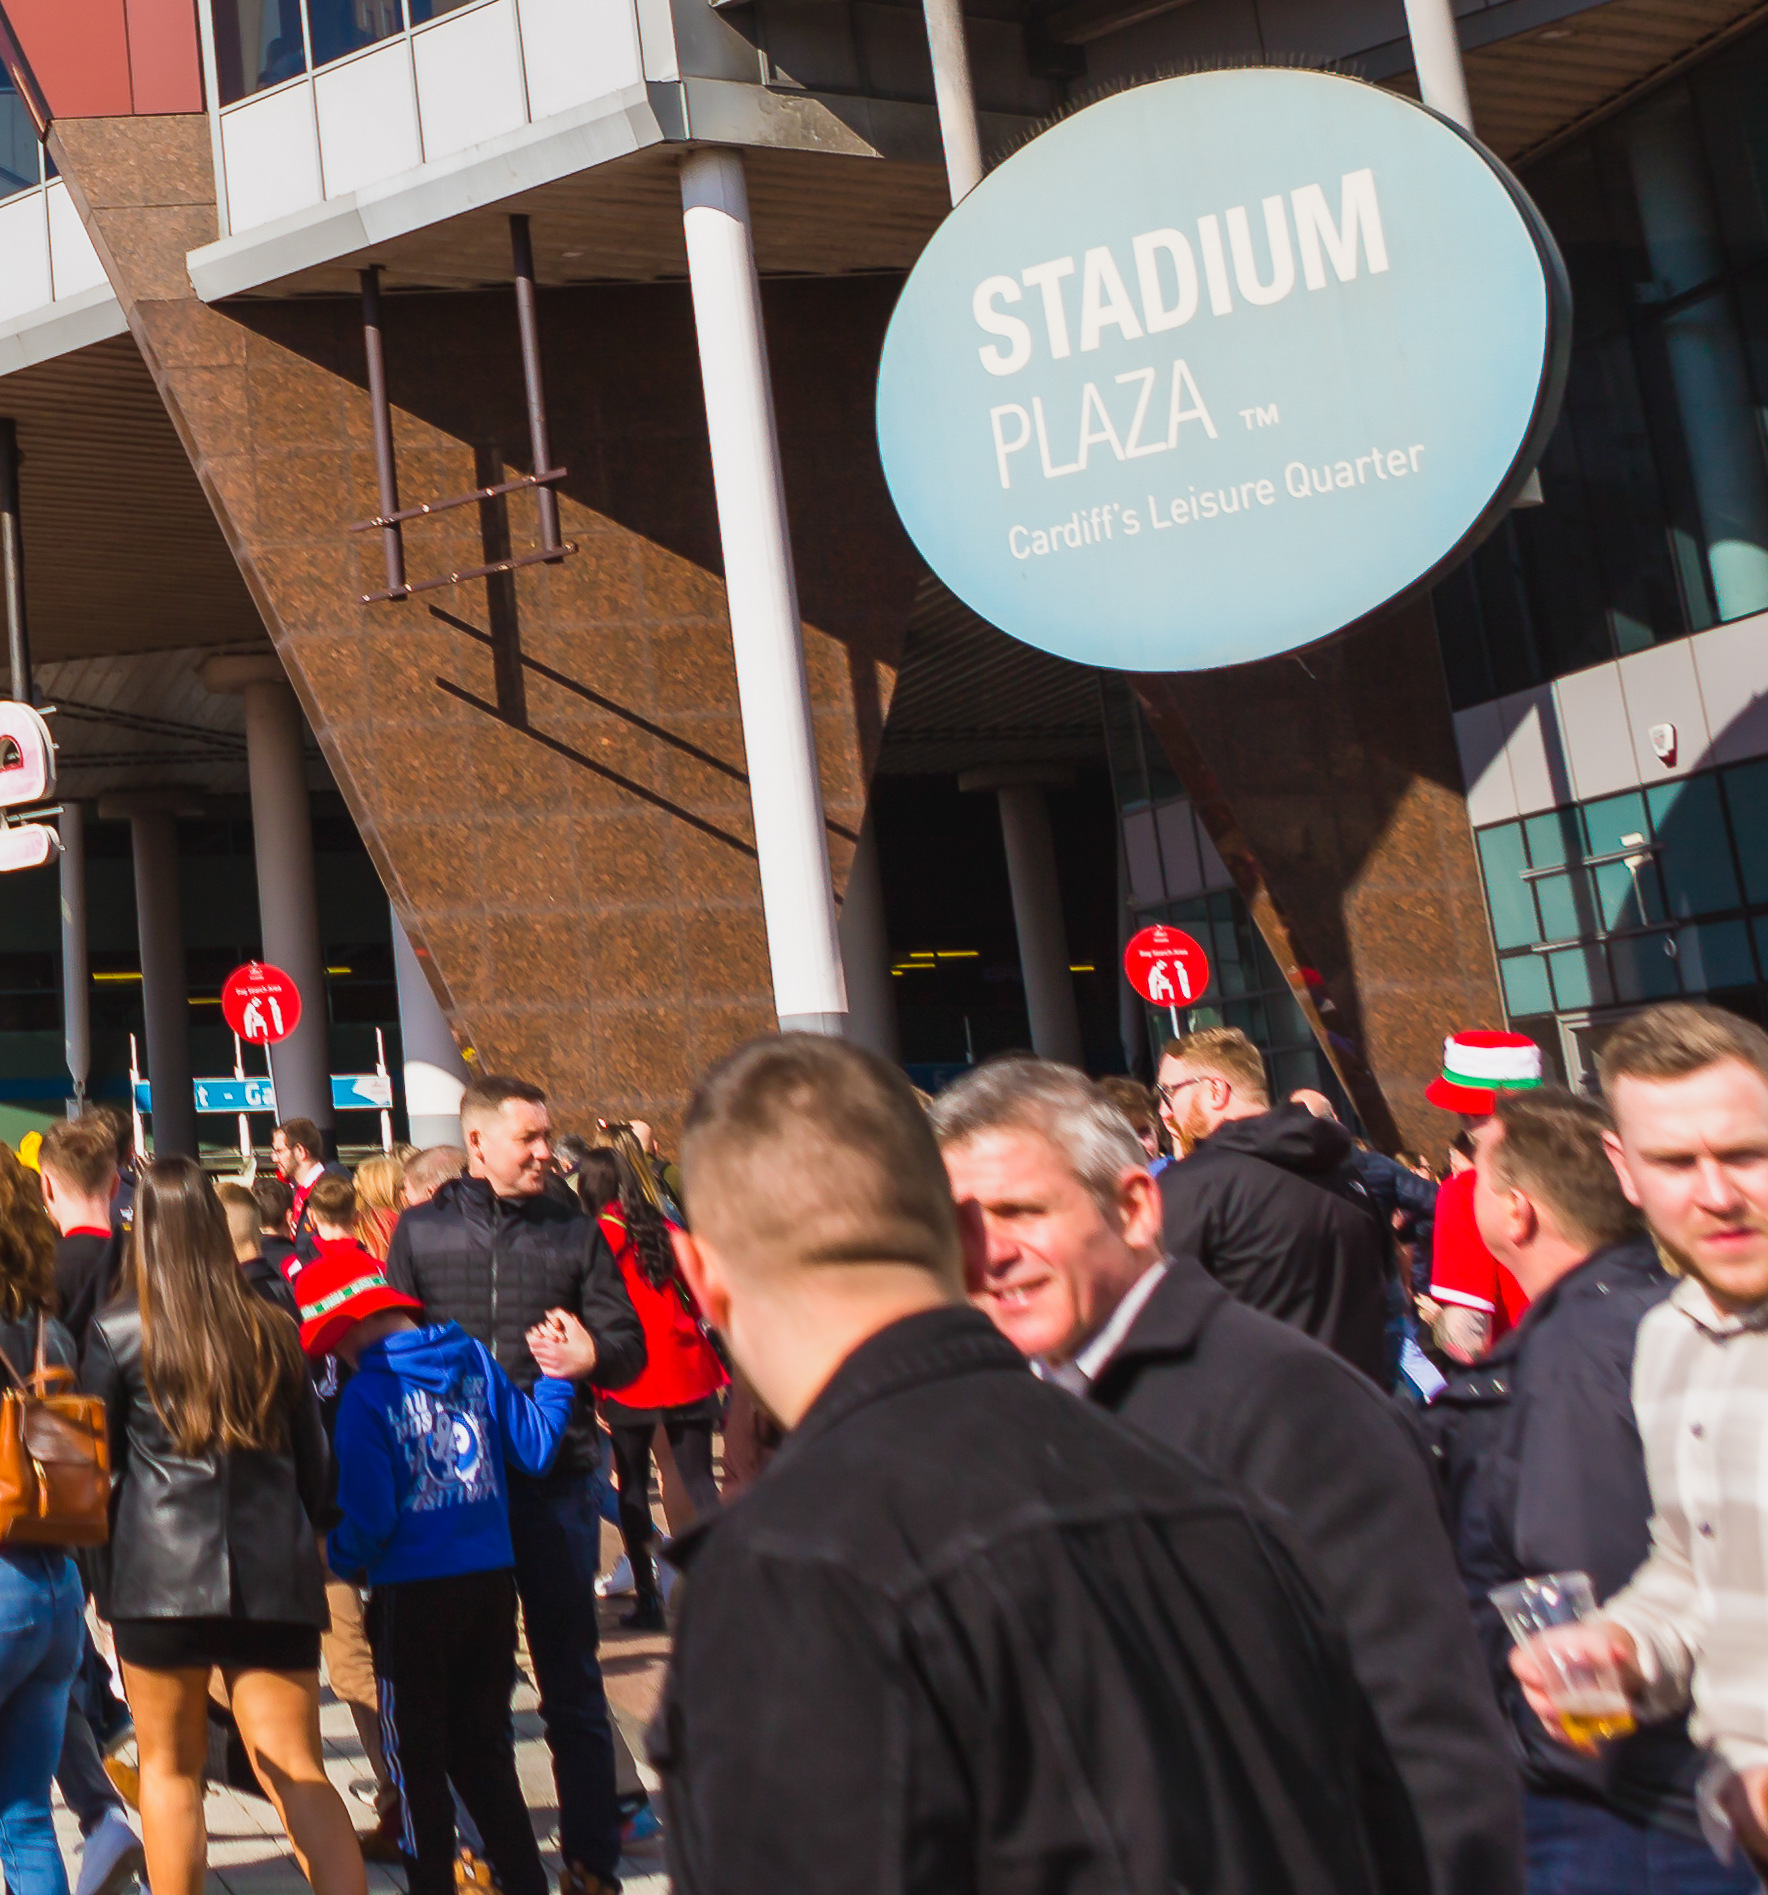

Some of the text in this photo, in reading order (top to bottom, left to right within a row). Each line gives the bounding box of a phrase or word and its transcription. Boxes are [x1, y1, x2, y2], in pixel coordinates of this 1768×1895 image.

[971, 167, 1390, 377] STADIUM
[989, 358, 1219, 490] PLAZA
[1008, 444, 1426, 560] Cardiff's Leisure Quarter
